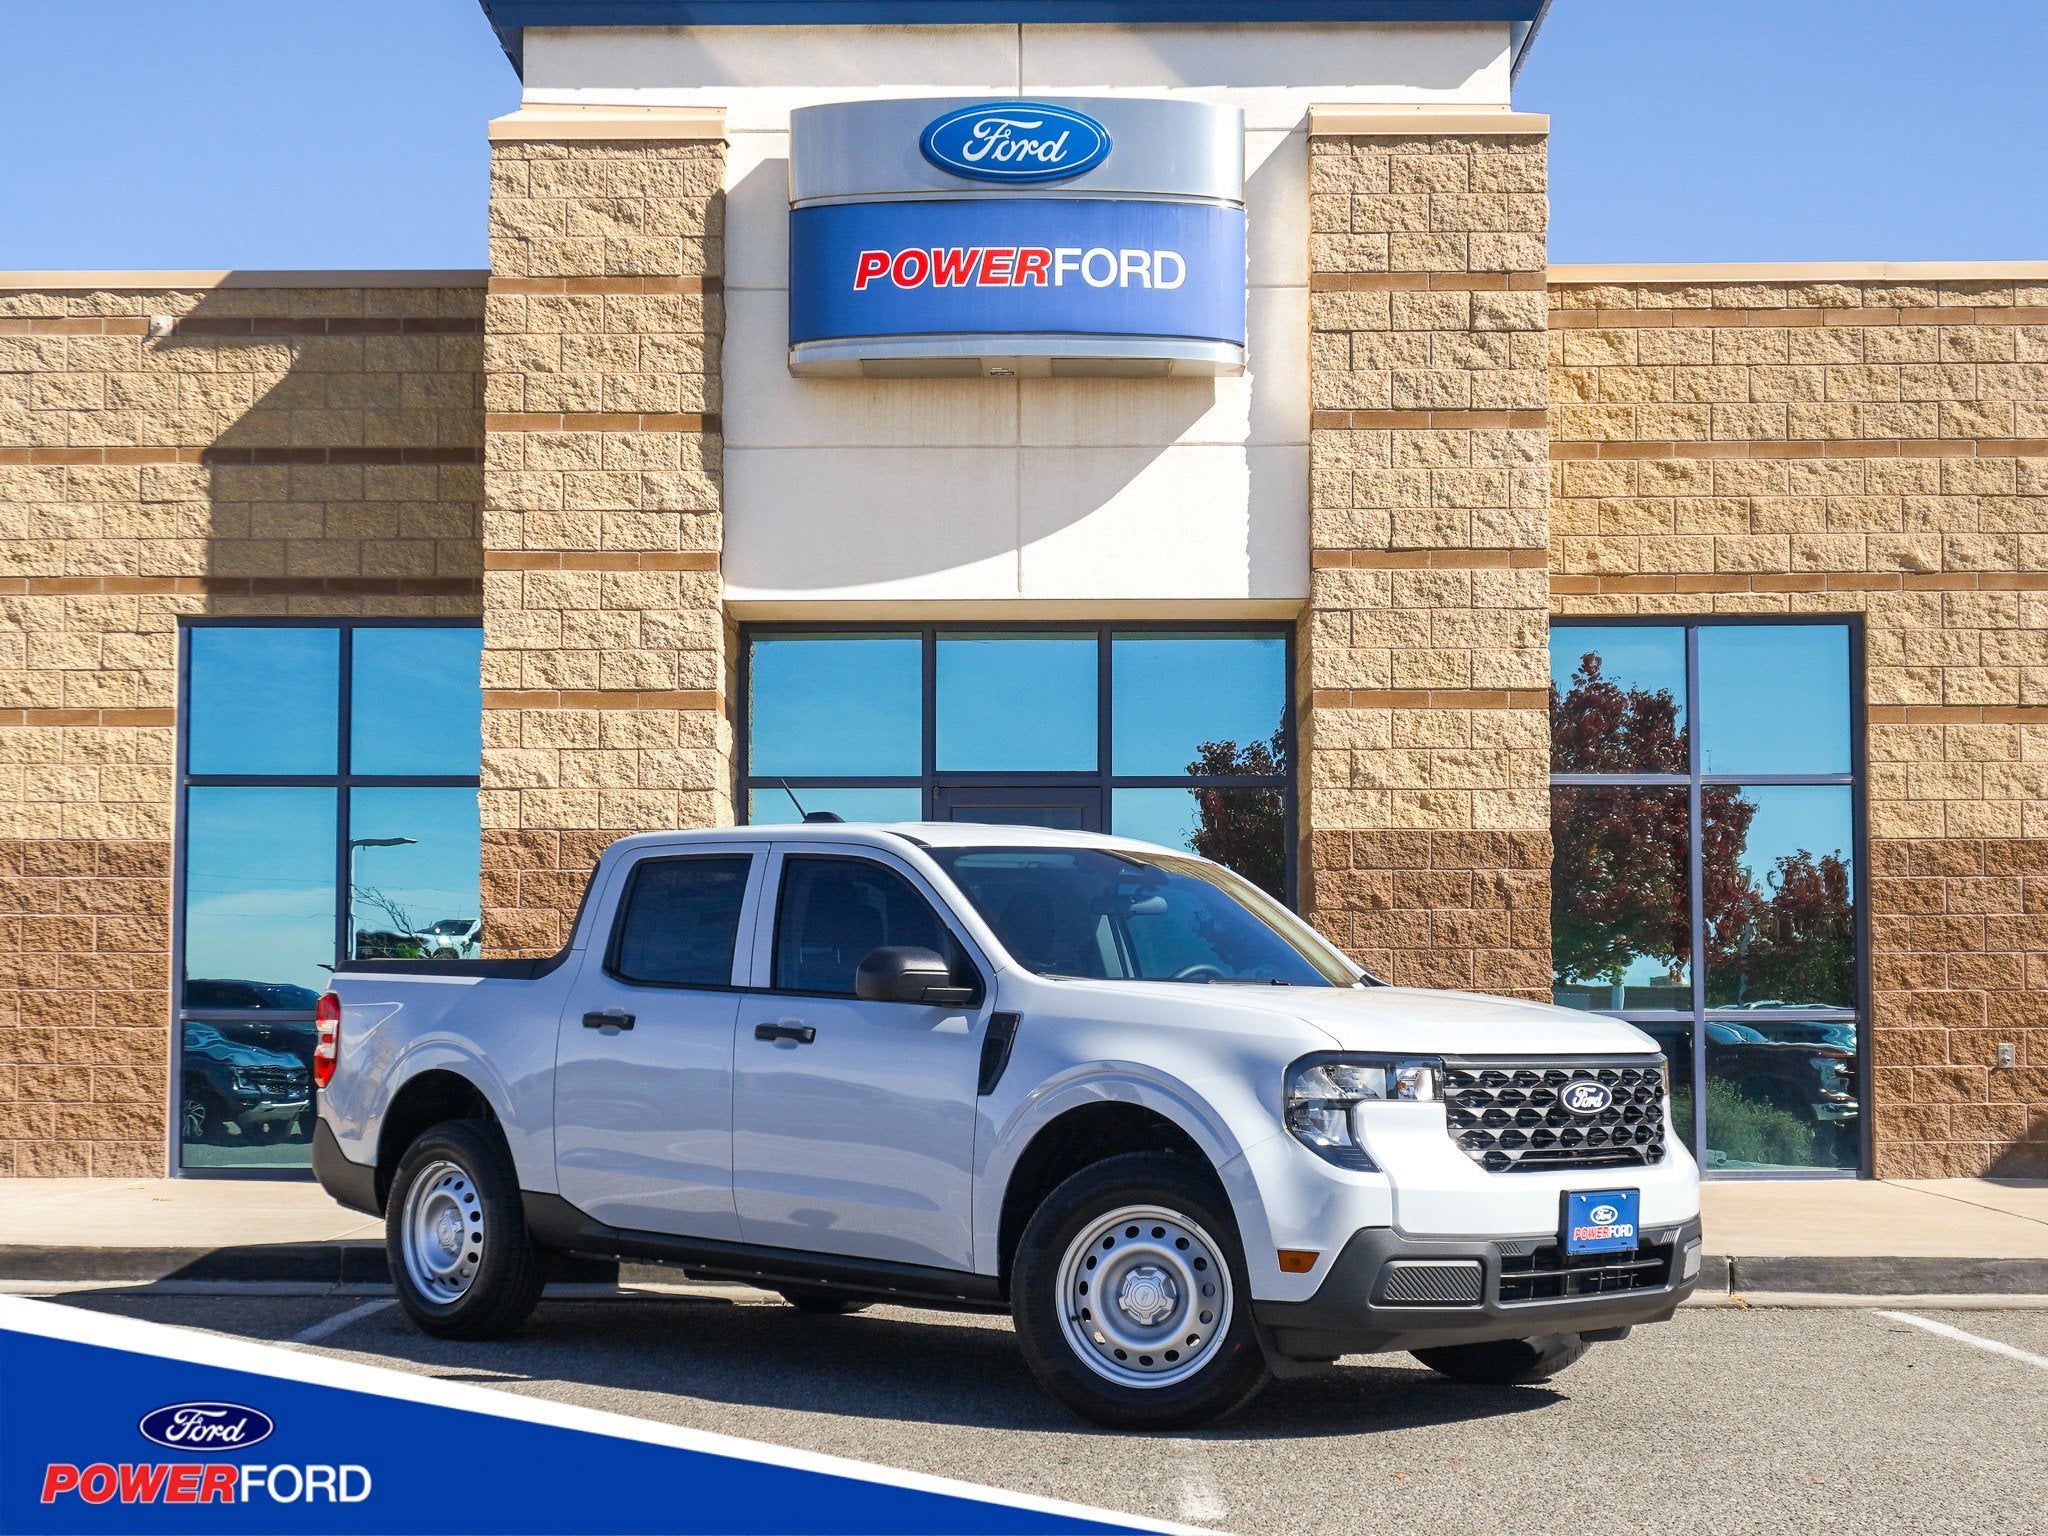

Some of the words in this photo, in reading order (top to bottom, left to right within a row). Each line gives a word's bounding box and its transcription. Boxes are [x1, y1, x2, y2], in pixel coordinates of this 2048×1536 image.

[962, 118, 1068, 164] Ford
[854, 247, 1186, 290] POWERFORD
[1573, 1087, 1603, 1108] Ford
